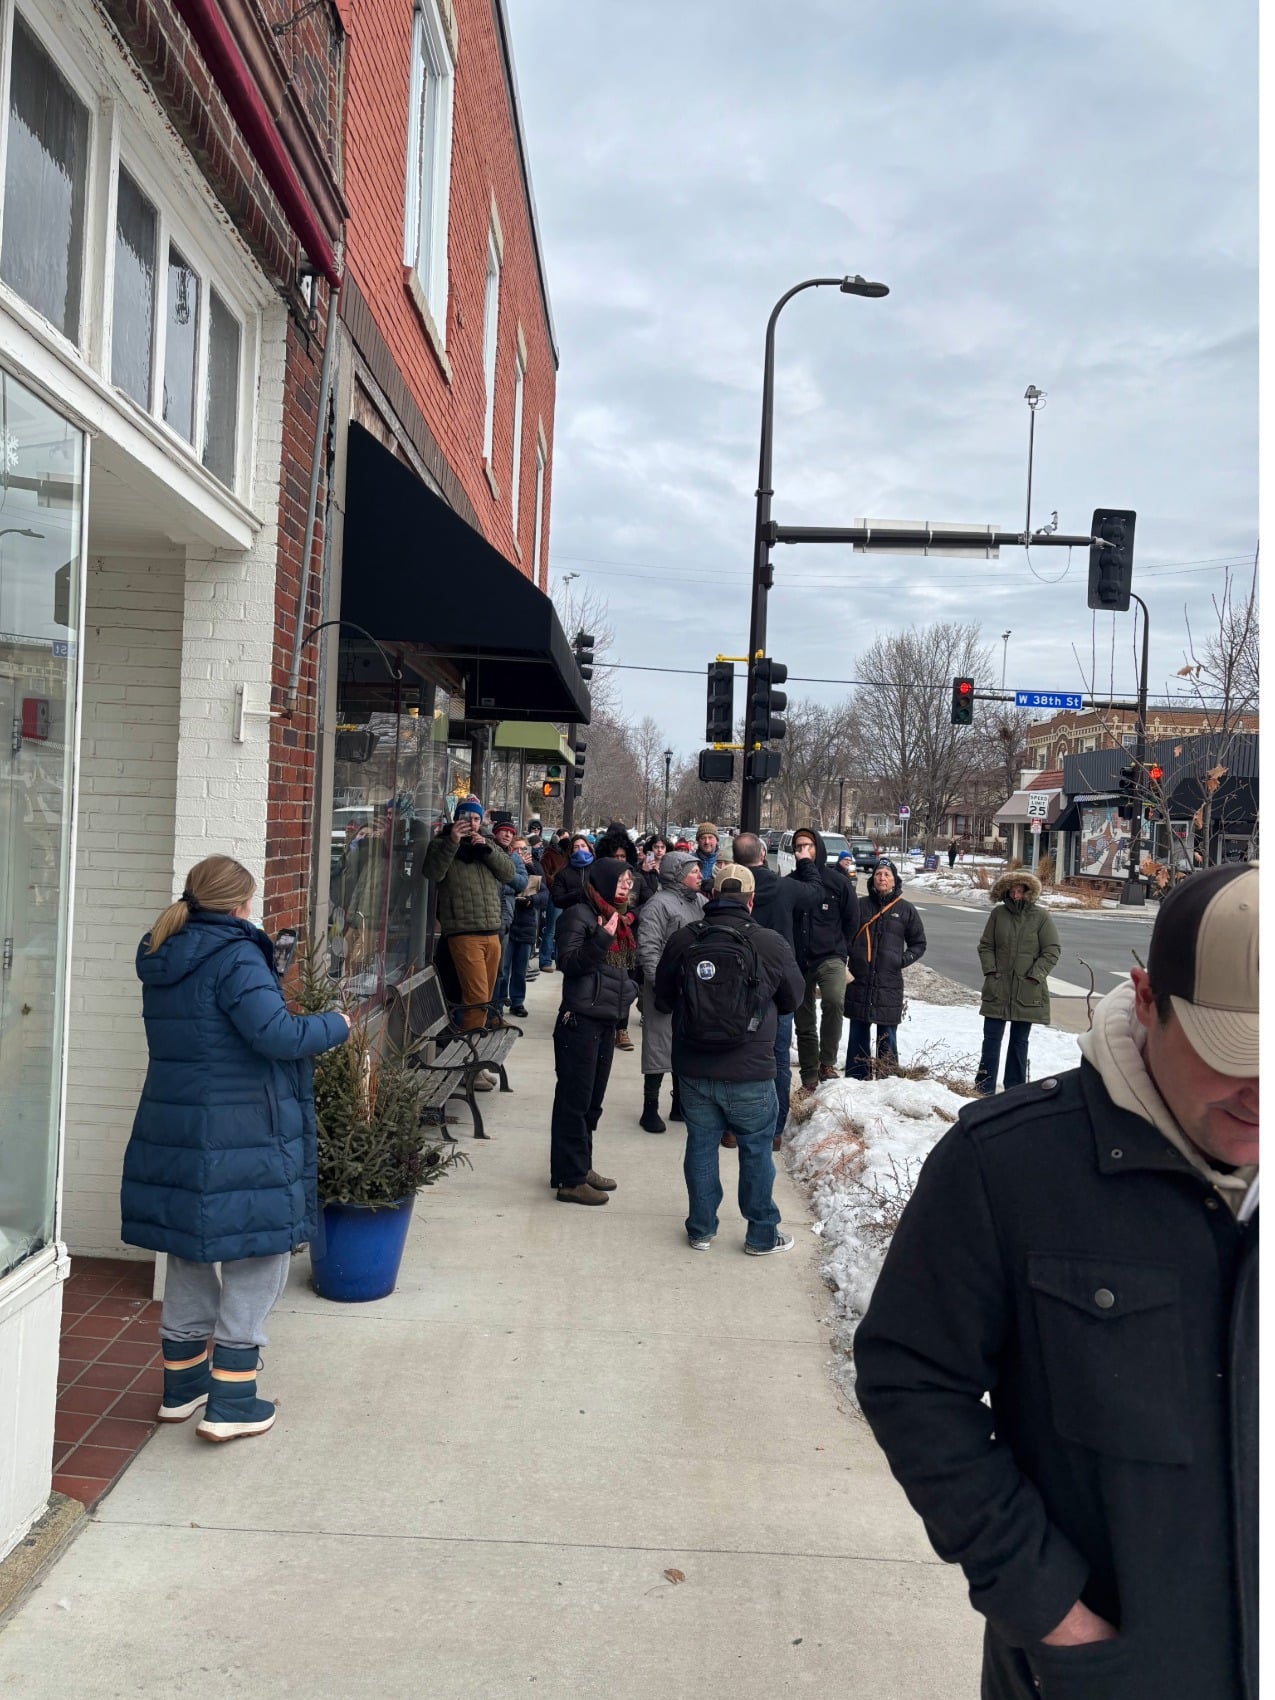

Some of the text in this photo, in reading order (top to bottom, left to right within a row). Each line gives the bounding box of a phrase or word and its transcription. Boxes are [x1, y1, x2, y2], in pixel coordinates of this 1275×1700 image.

[1018, 694, 1079, 707] W 38th St
[1029, 805, 1046, 816] 25
